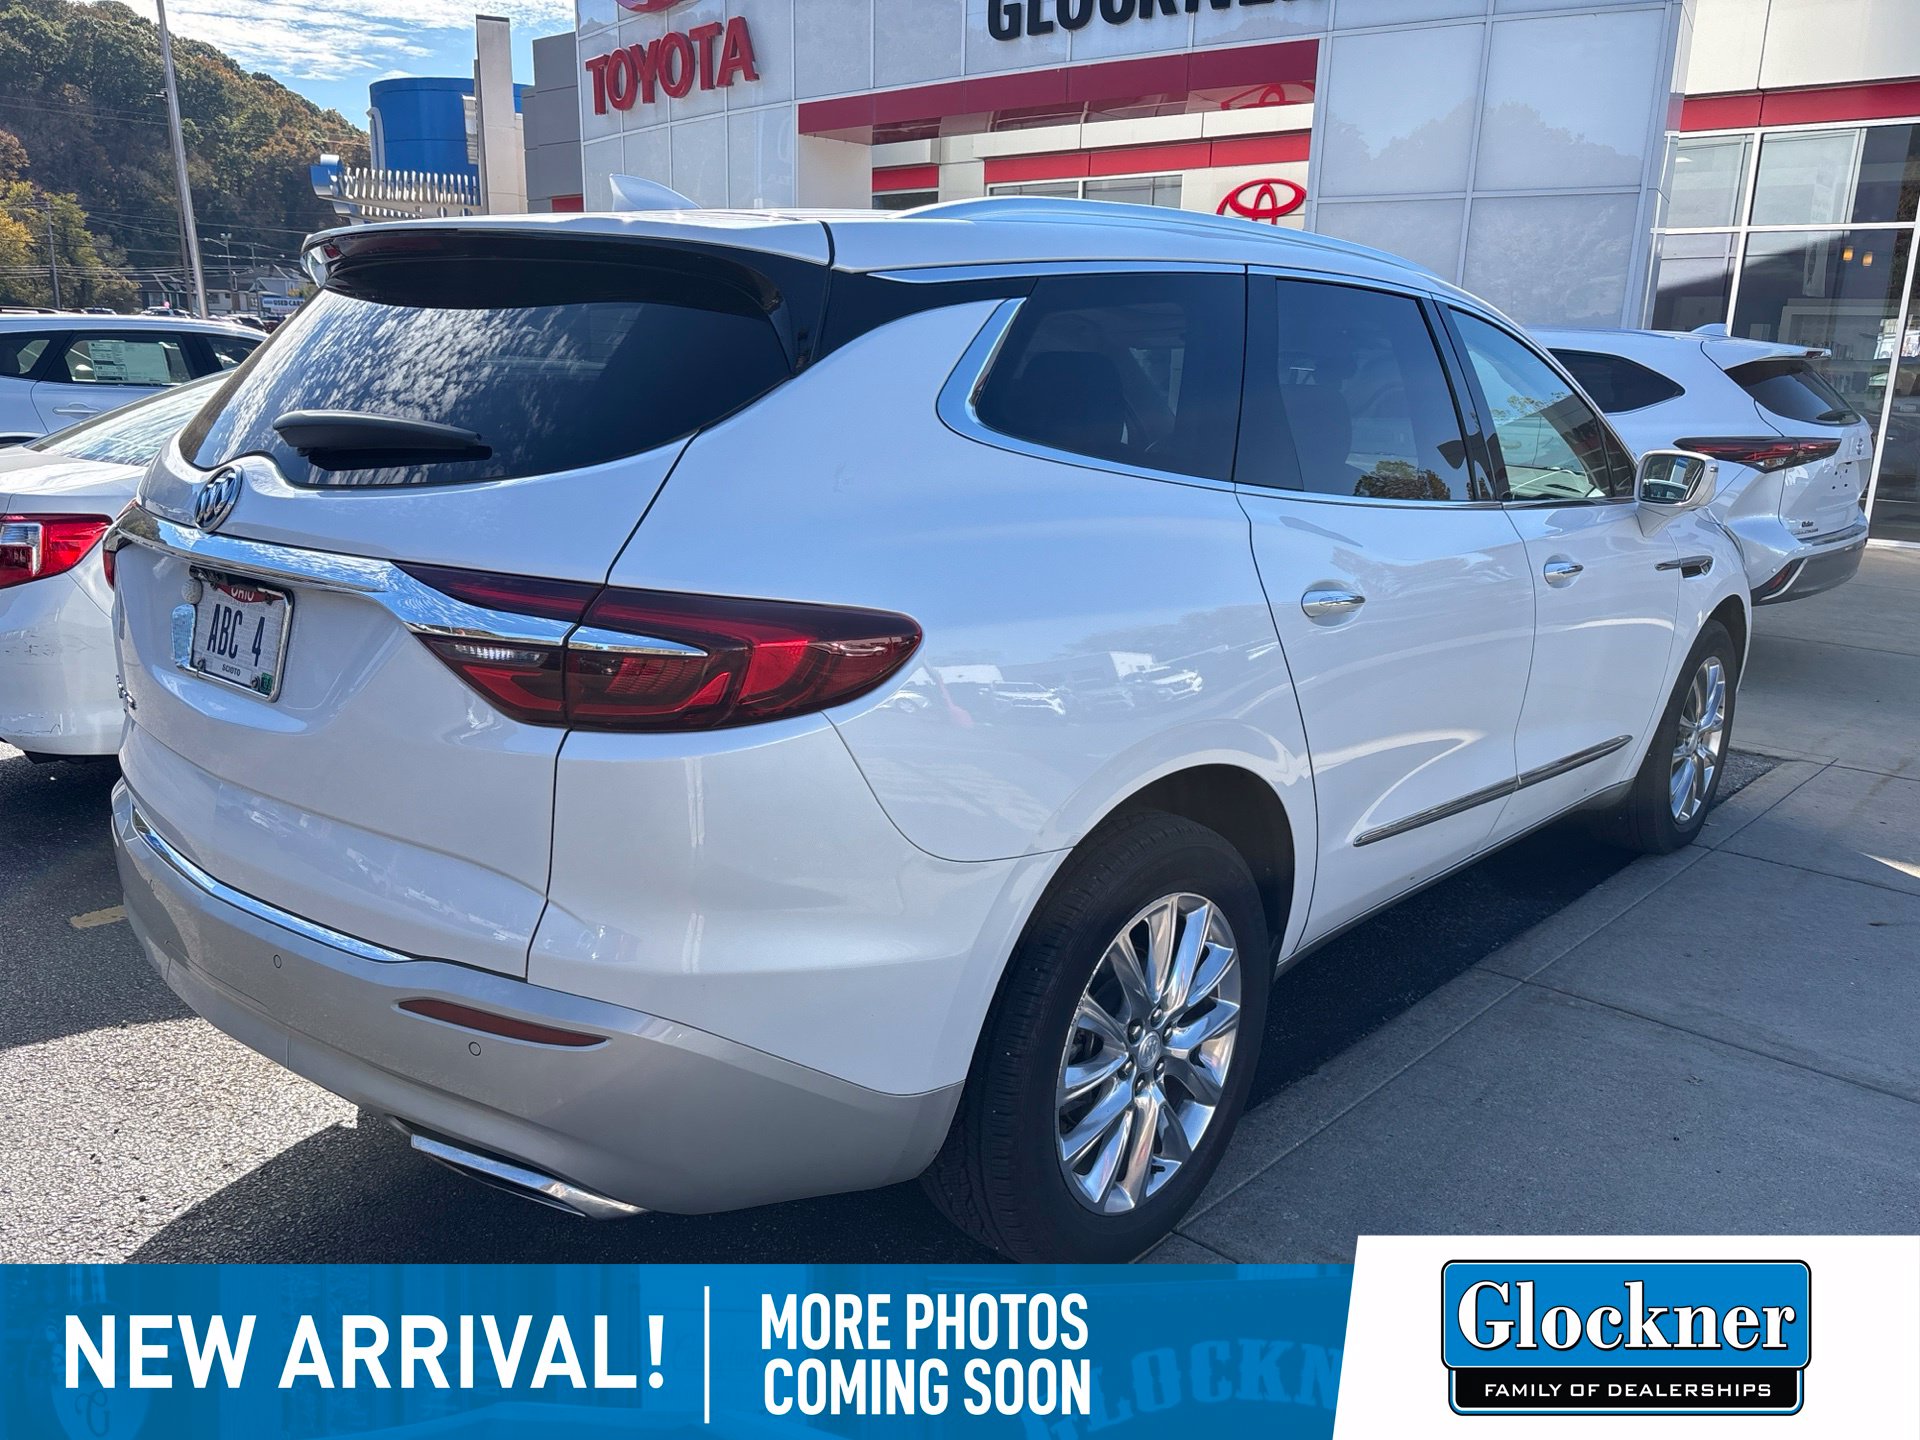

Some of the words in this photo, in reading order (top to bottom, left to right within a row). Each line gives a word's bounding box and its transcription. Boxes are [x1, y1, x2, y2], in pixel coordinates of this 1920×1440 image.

[585, 16, 760, 115] TOYOTA
[207, 603, 243, 659] ABC
[252, 616, 265, 667] 4
[222, 663, 241, 677] SCIOTO
